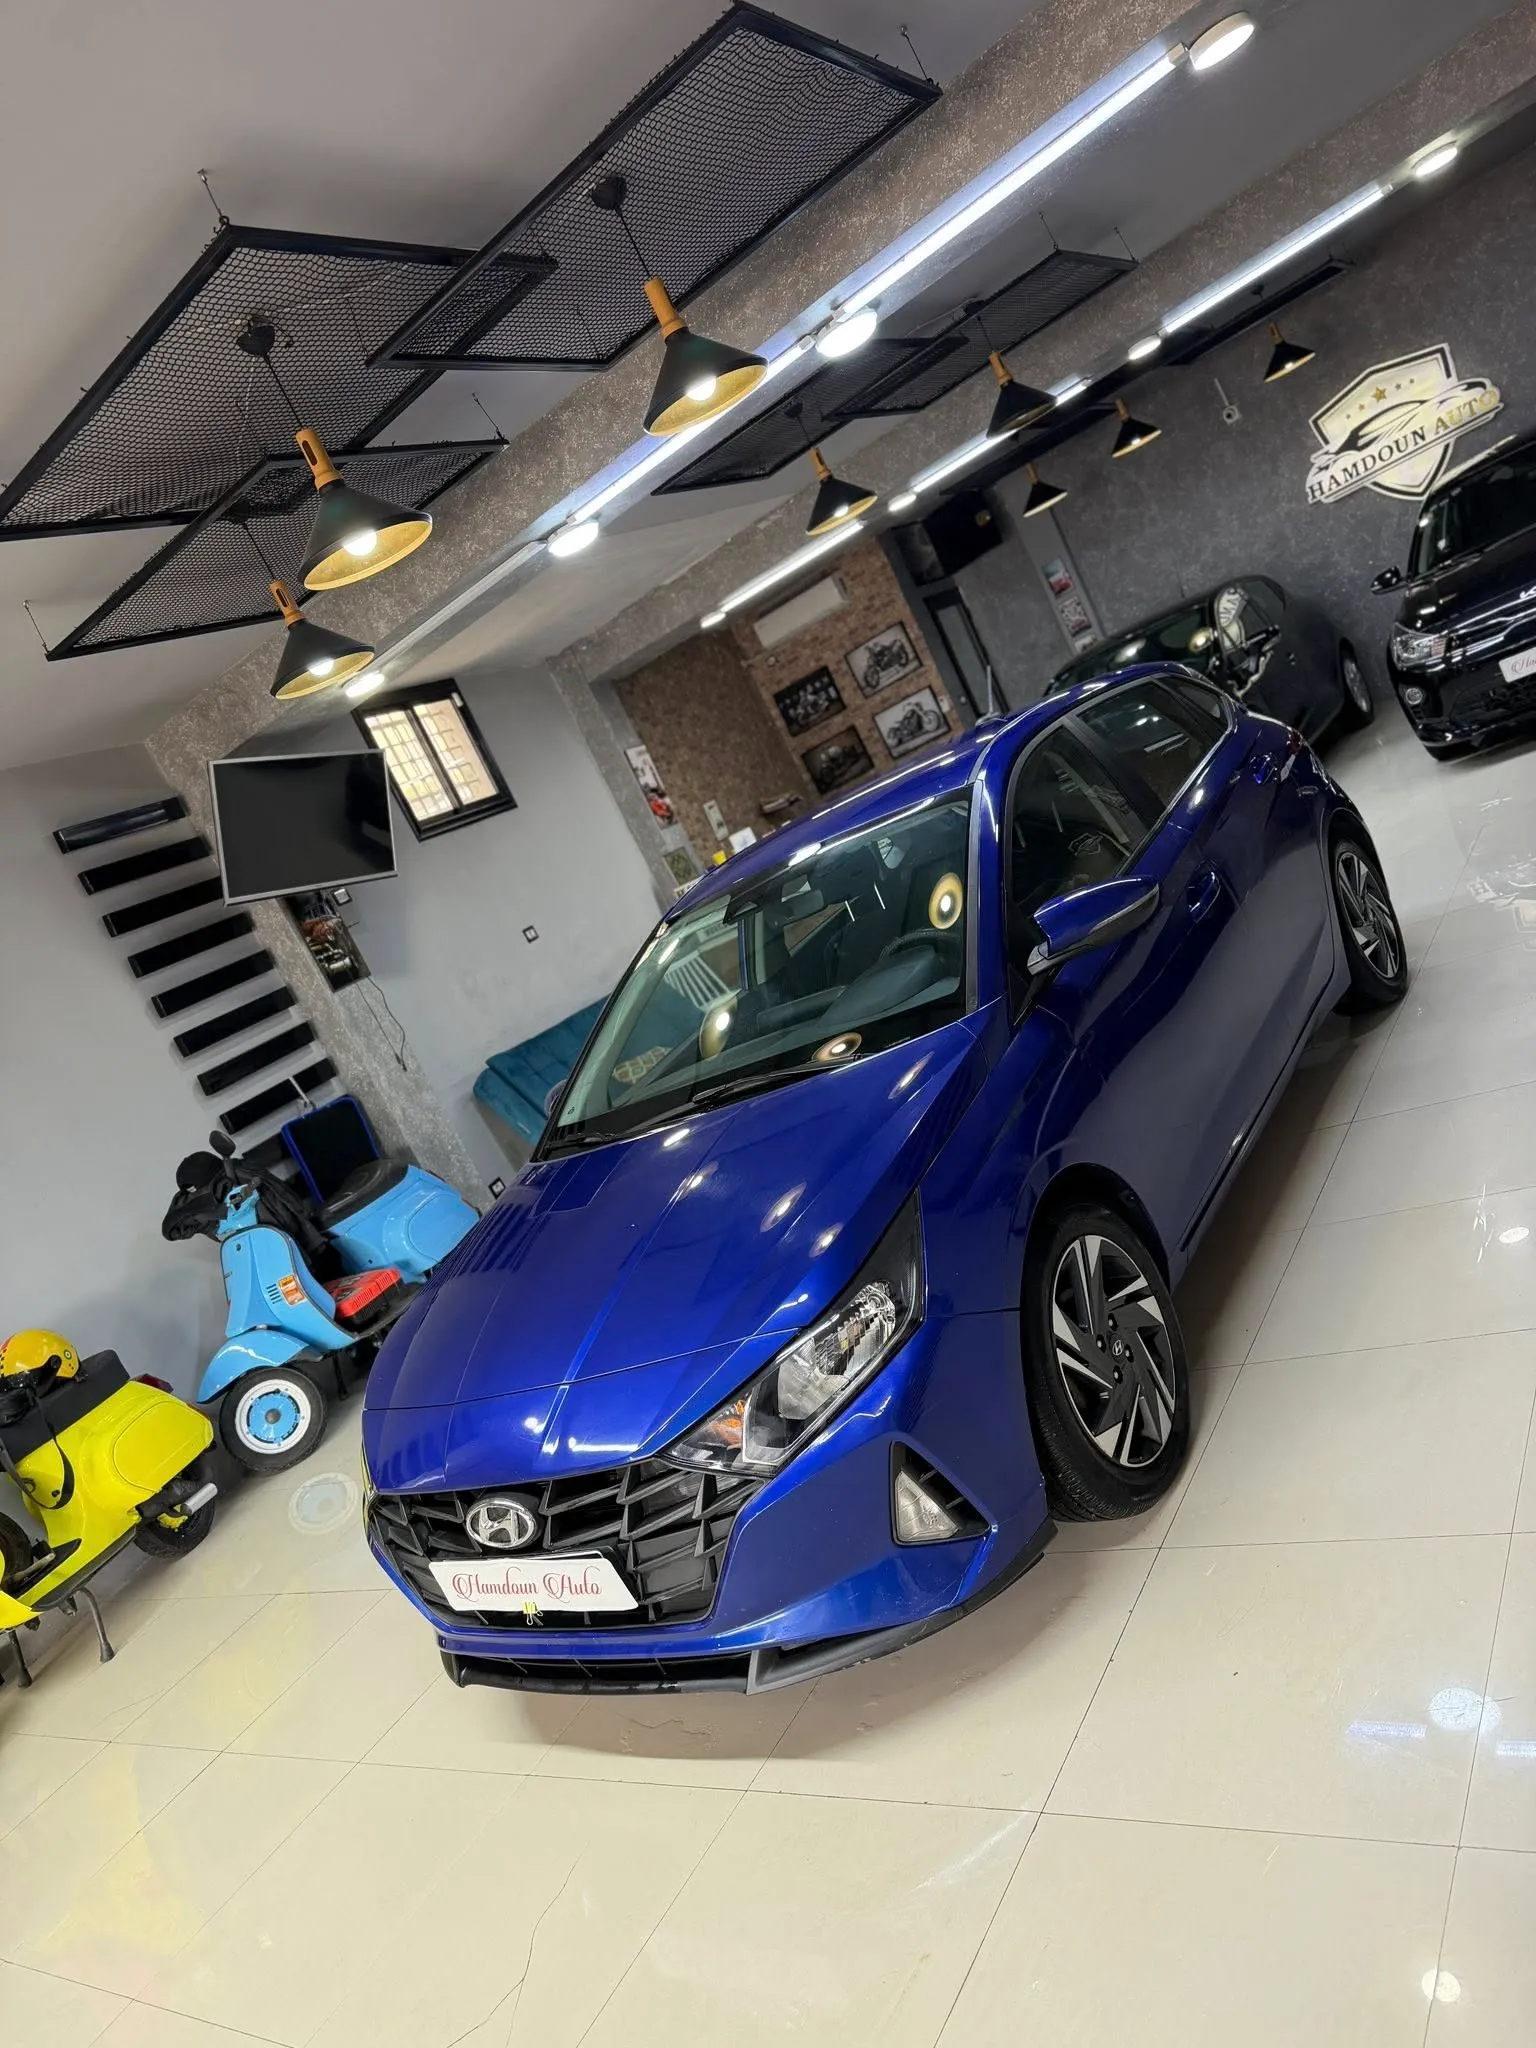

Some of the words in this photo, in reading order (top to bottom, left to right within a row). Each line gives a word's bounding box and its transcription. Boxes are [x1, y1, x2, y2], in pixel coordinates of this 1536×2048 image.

[1308, 427, 1426, 501] HAMDOUN
[1434, 390, 1498, 434] AUTO
[452, 1566, 539, 1602] Hamdoun
